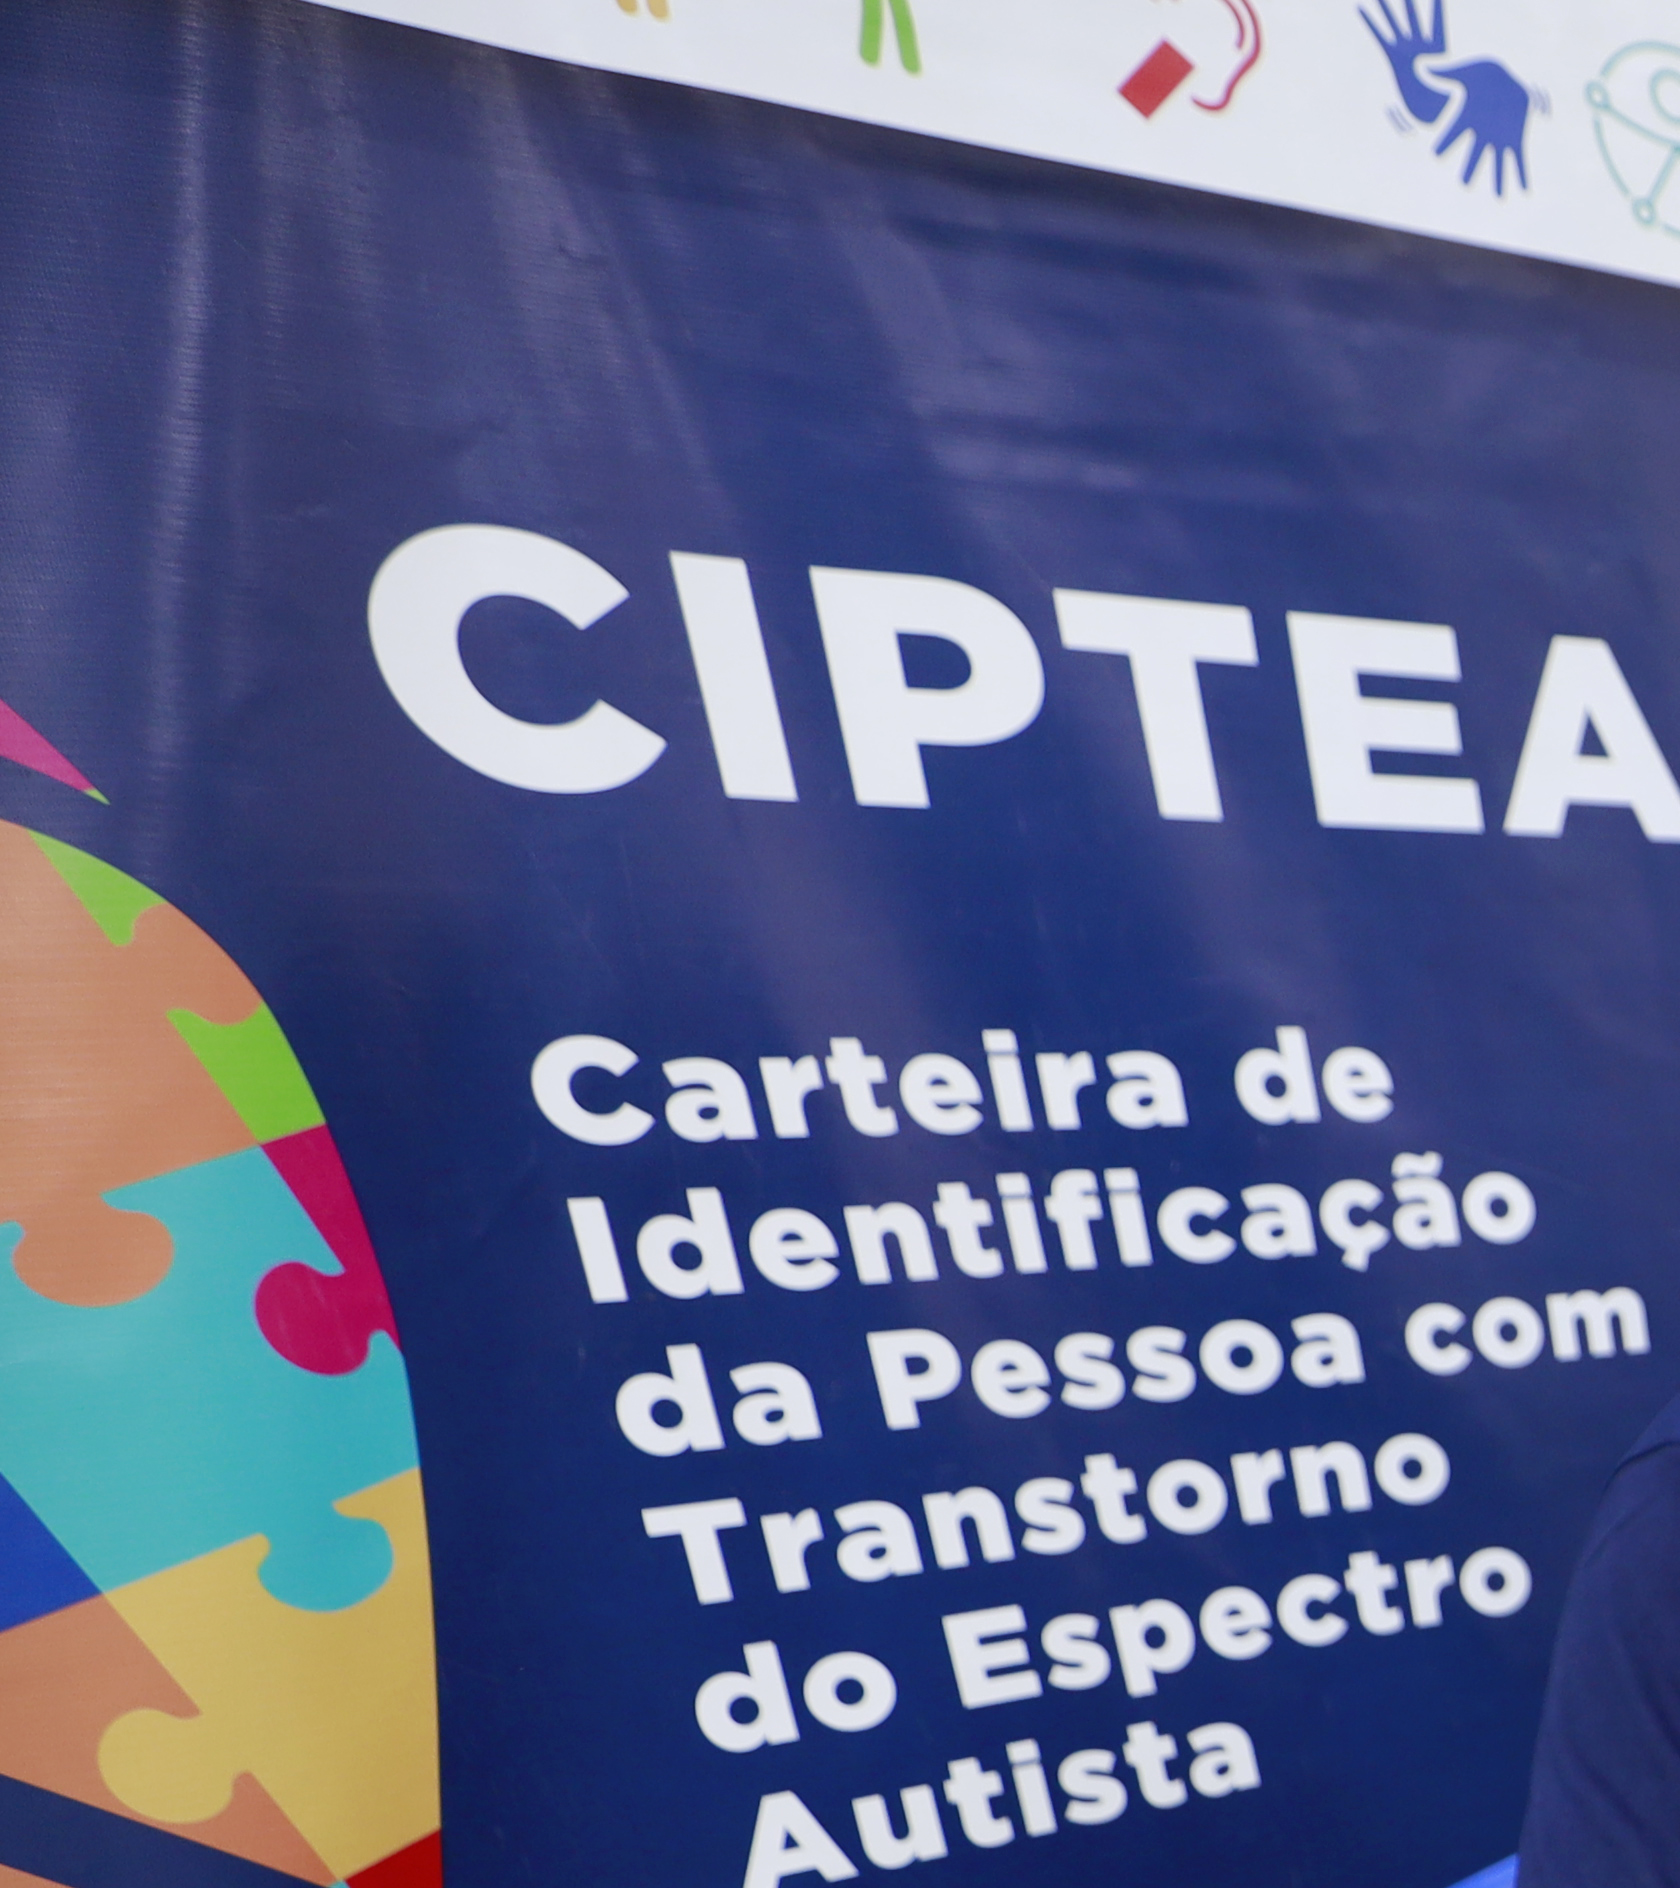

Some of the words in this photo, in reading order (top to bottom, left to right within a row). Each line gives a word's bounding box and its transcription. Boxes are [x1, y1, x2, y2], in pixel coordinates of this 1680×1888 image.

[532, 1030, 1186, 1144] Carteira
[1236, 1027, 1391, 1123] de
[568, 1153, 1534, 1302] Identificação
[617, 1345, 820, 1455] da
[868, 1314, 1363, 1428] Pessoa
[1406, 1288, 1647, 1372] com
[642, 1435, 1447, 1603] Transtorno
[696, 1642, 895, 1751] do
[943, 1548, 1529, 1707] Espectro
